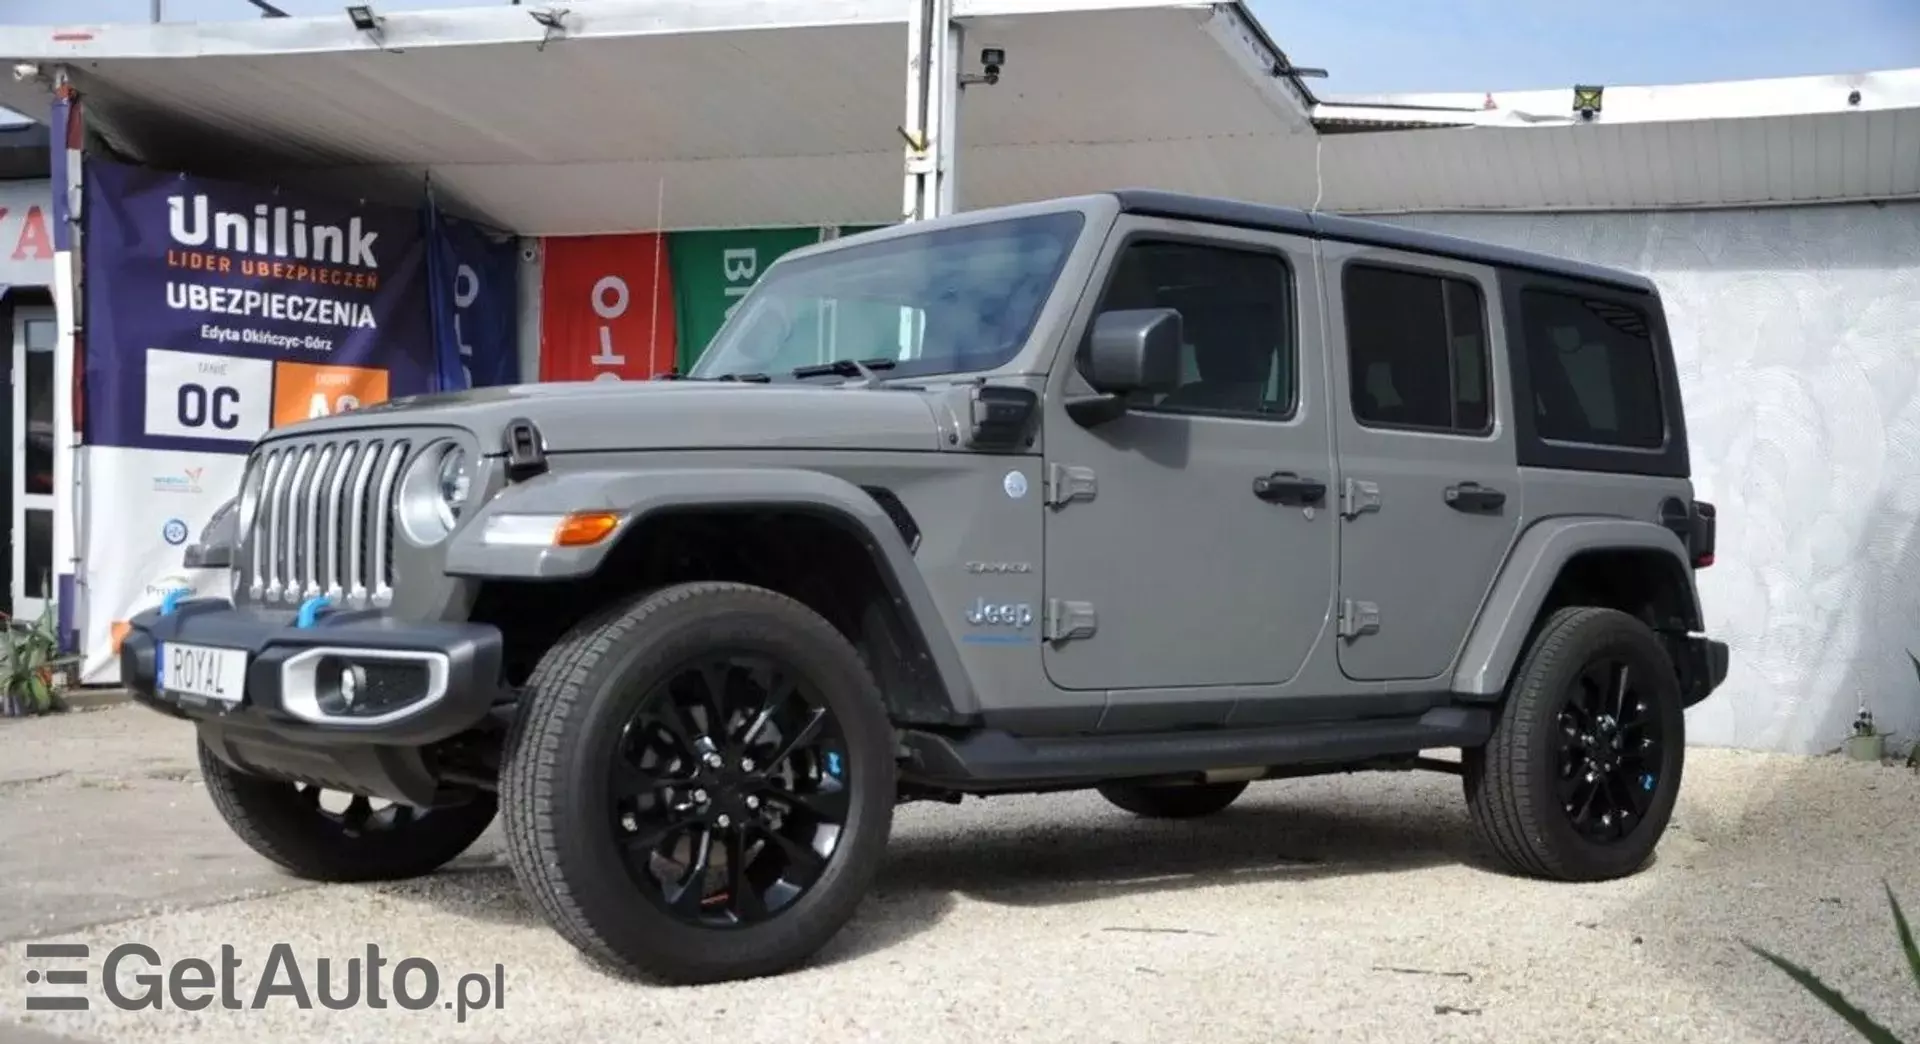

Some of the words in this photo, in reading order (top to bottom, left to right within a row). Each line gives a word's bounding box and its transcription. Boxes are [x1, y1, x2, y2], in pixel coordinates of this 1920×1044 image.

[0, 205, 54, 260] A
[167, 194, 379, 268] Unilink
[167, 250, 232, 273] LIDER
[241, 259, 379, 290] UBEZPIECZEŃ
[166, 281, 377, 330] UBEZPIECZENIA
[201, 324, 240, 344] Edyta
[177, 383, 240, 430] OC
[965, 595, 1032, 629] Jeep
[173, 647, 224, 694] ROYAL
